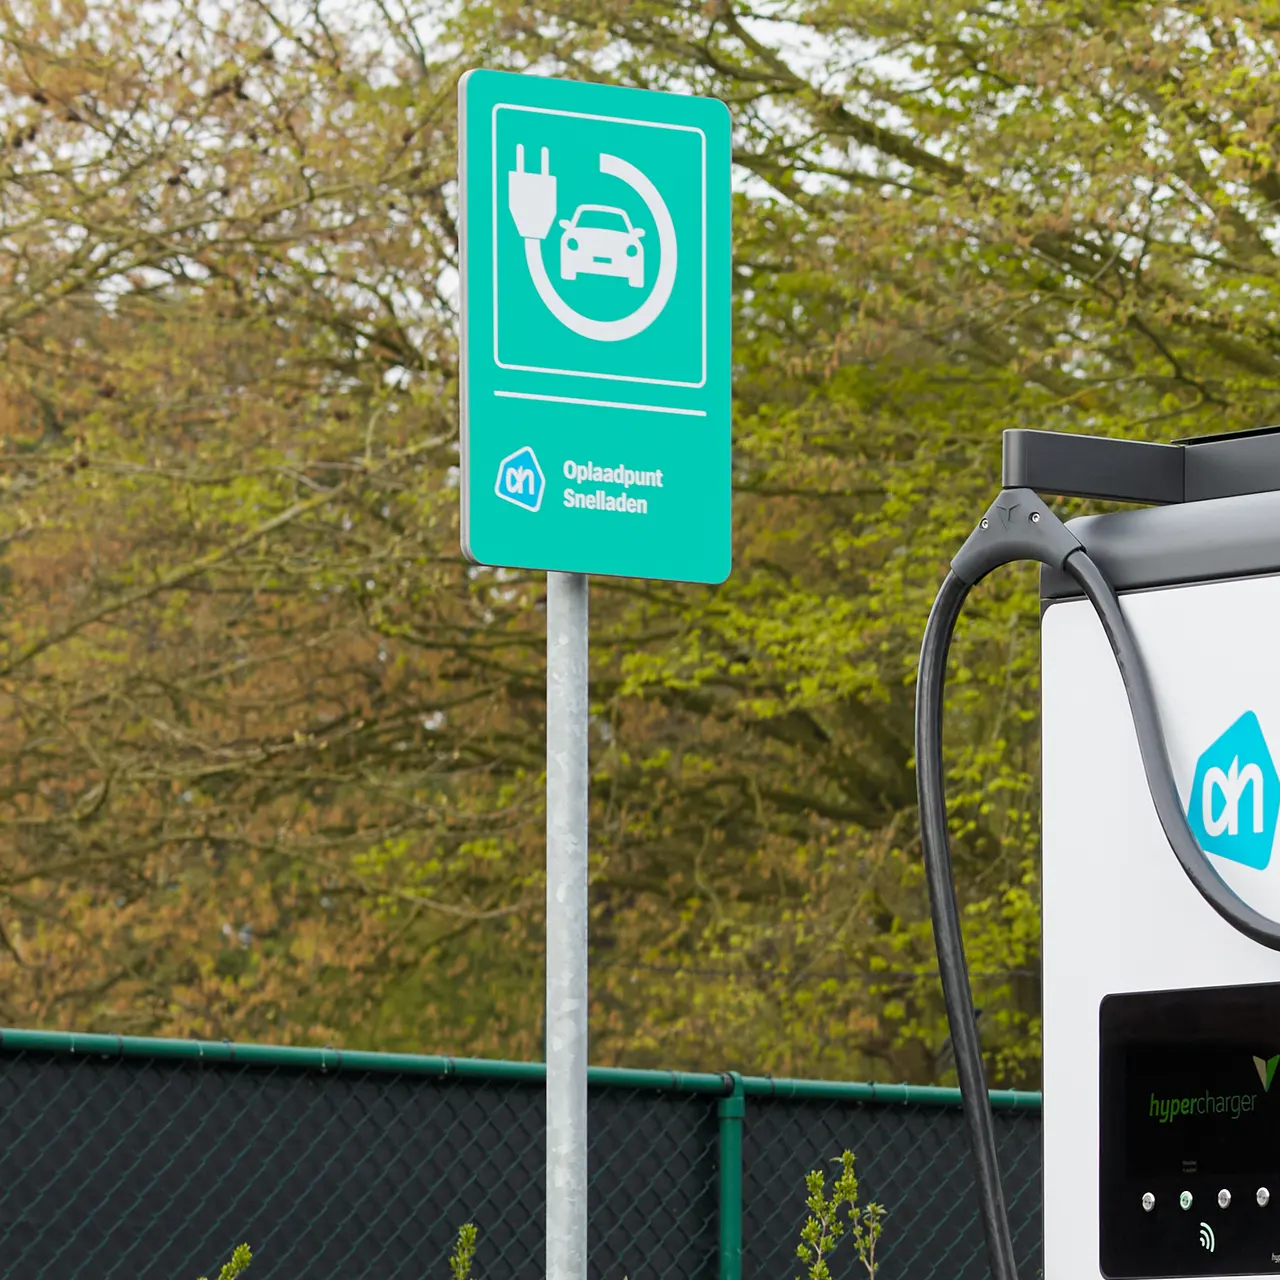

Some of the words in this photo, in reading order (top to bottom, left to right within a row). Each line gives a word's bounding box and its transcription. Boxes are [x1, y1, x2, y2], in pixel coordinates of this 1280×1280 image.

[563, 459, 664, 489] Oplaadpunt
[563, 488, 648, 514] Snelladen
[1149, 1089, 1258, 1122] hypercharger
